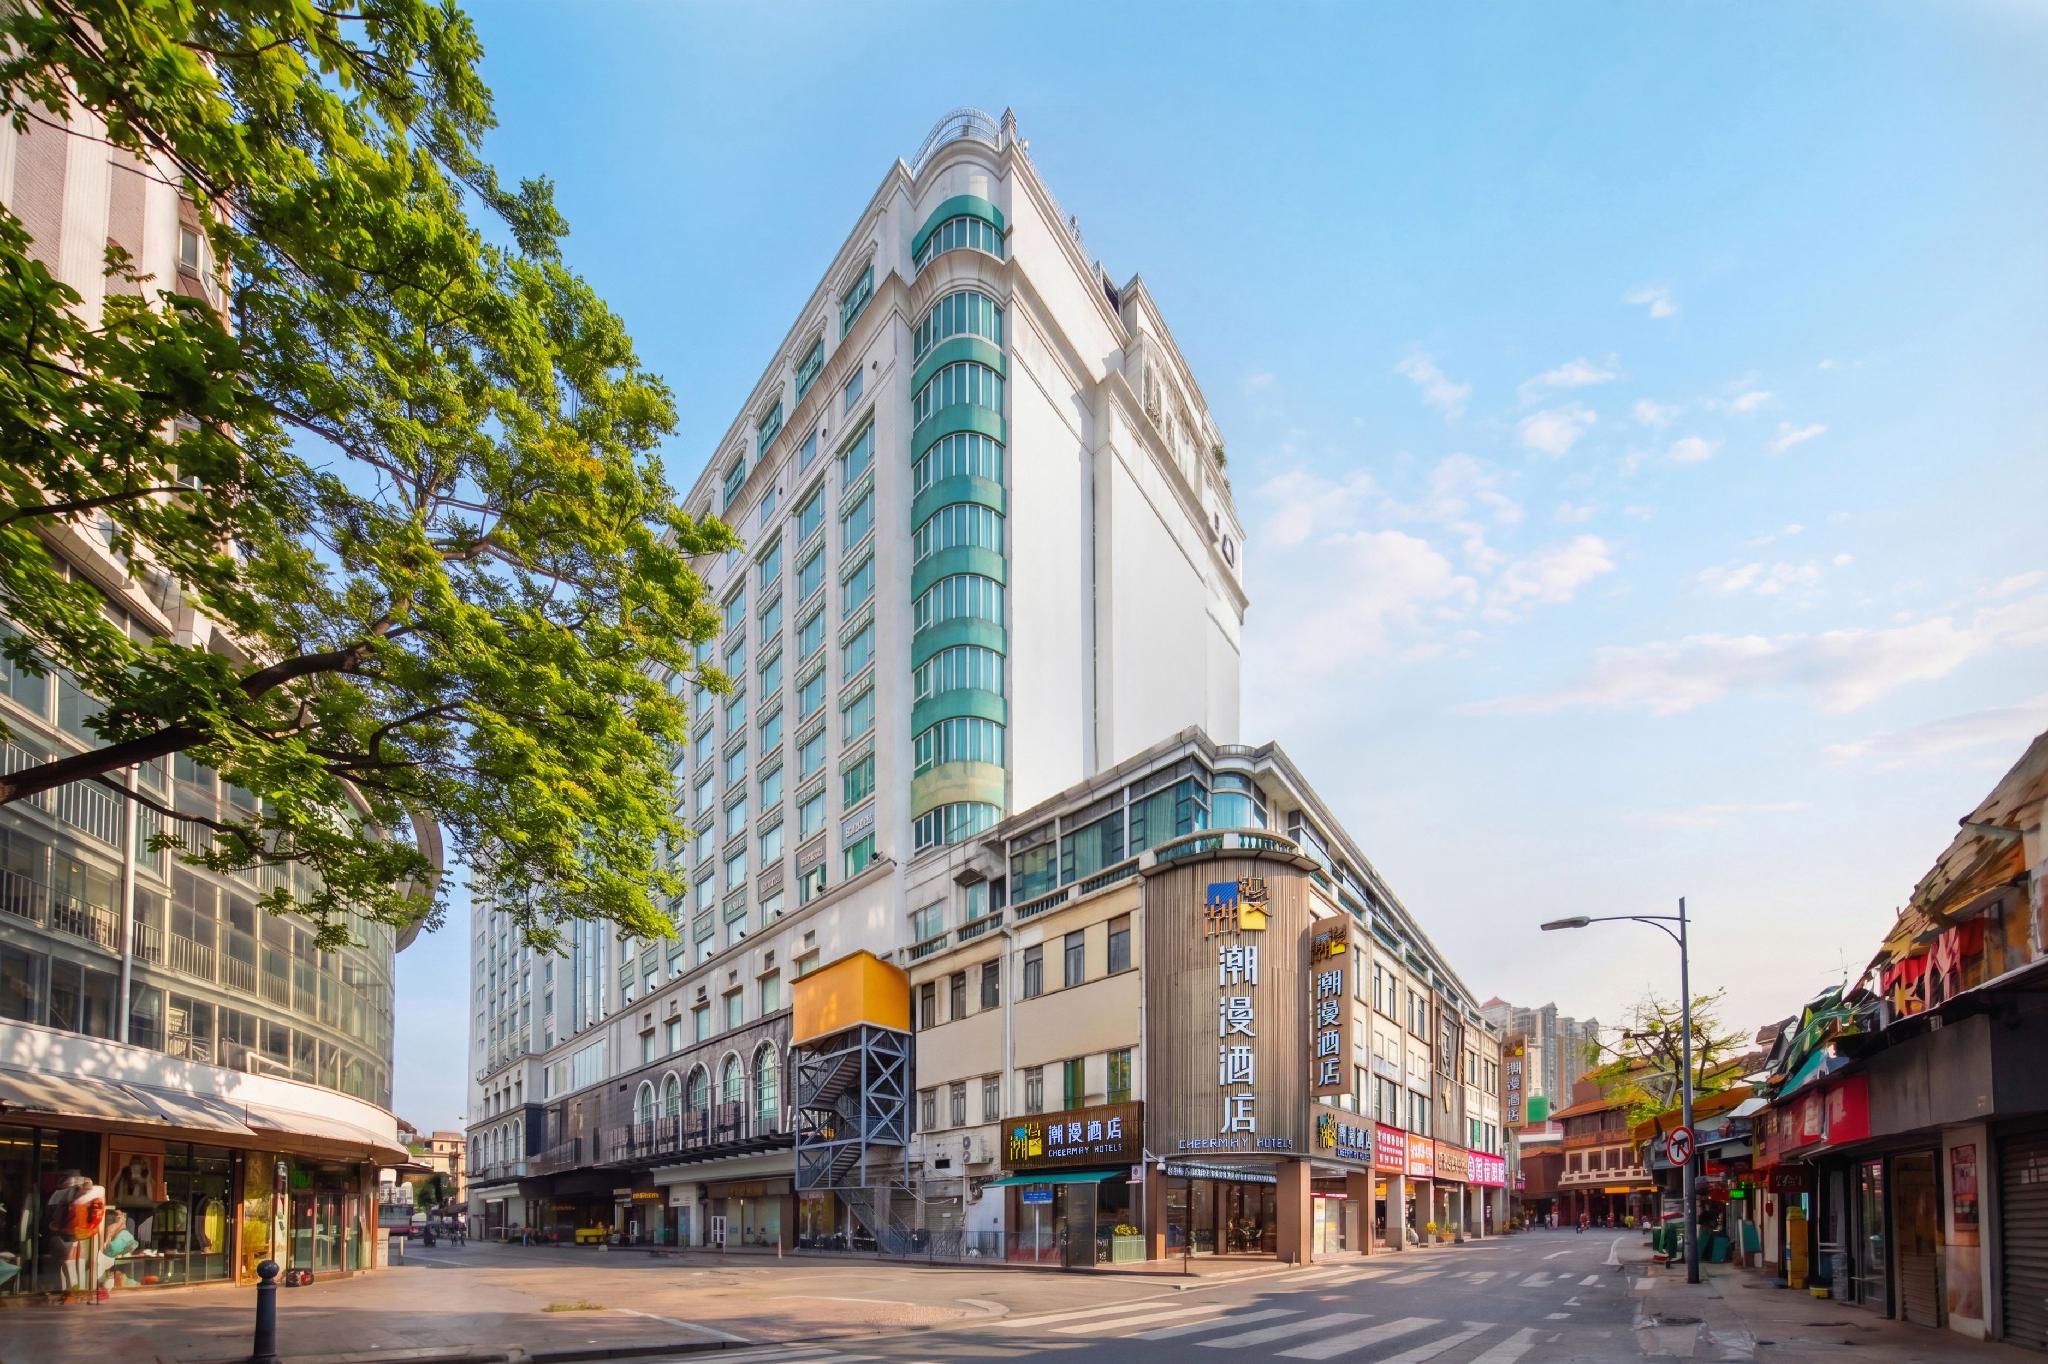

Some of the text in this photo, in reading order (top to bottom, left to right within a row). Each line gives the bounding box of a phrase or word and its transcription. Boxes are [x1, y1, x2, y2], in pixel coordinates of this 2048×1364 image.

[1219, 945, 1257, 1134] 潮漫酒店
[1317, 969, 1343, 1087] 潮漫酒店
[1048, 1117, 1121, 1145] 潮漫酒店
[1179, 1137, 1293, 1149] CHEERMAY HOTELS
[1048, 1143, 1122, 1158] CHEERMAY HOTELS
